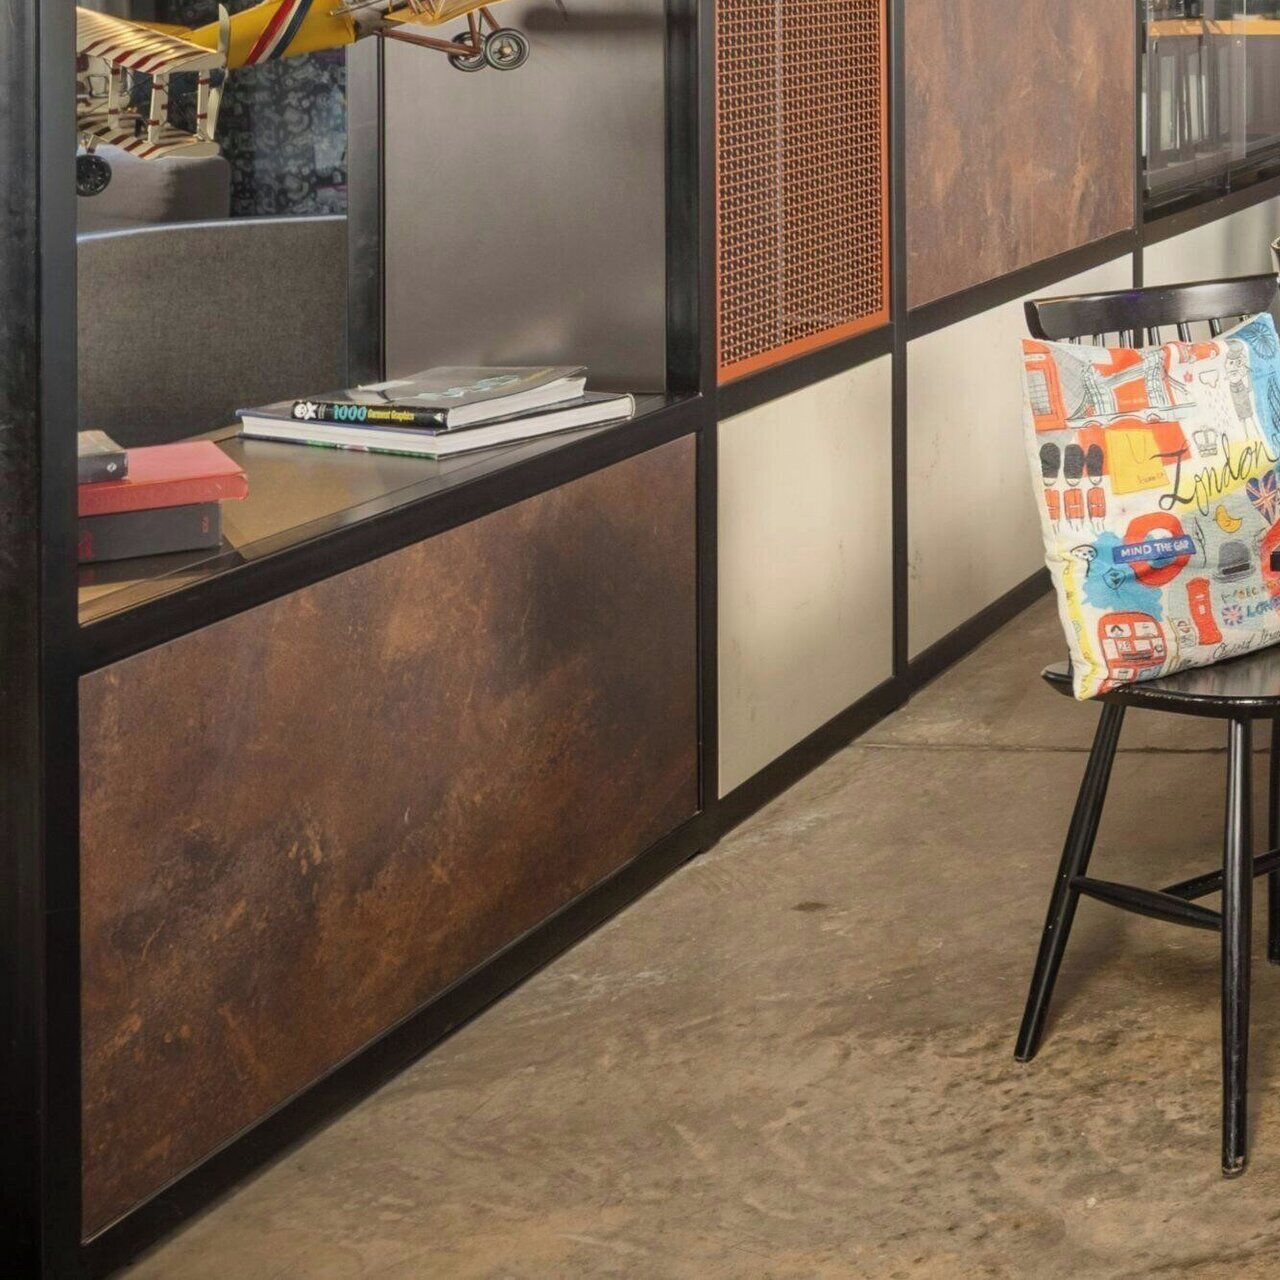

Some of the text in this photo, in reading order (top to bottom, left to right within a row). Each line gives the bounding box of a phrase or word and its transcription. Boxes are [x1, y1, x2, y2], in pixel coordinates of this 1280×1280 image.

[333, 404, 367, 420] 1000
[391, 409, 415, 421] Graphics
[1120, 539, 1191, 557] MIND THE GAP
